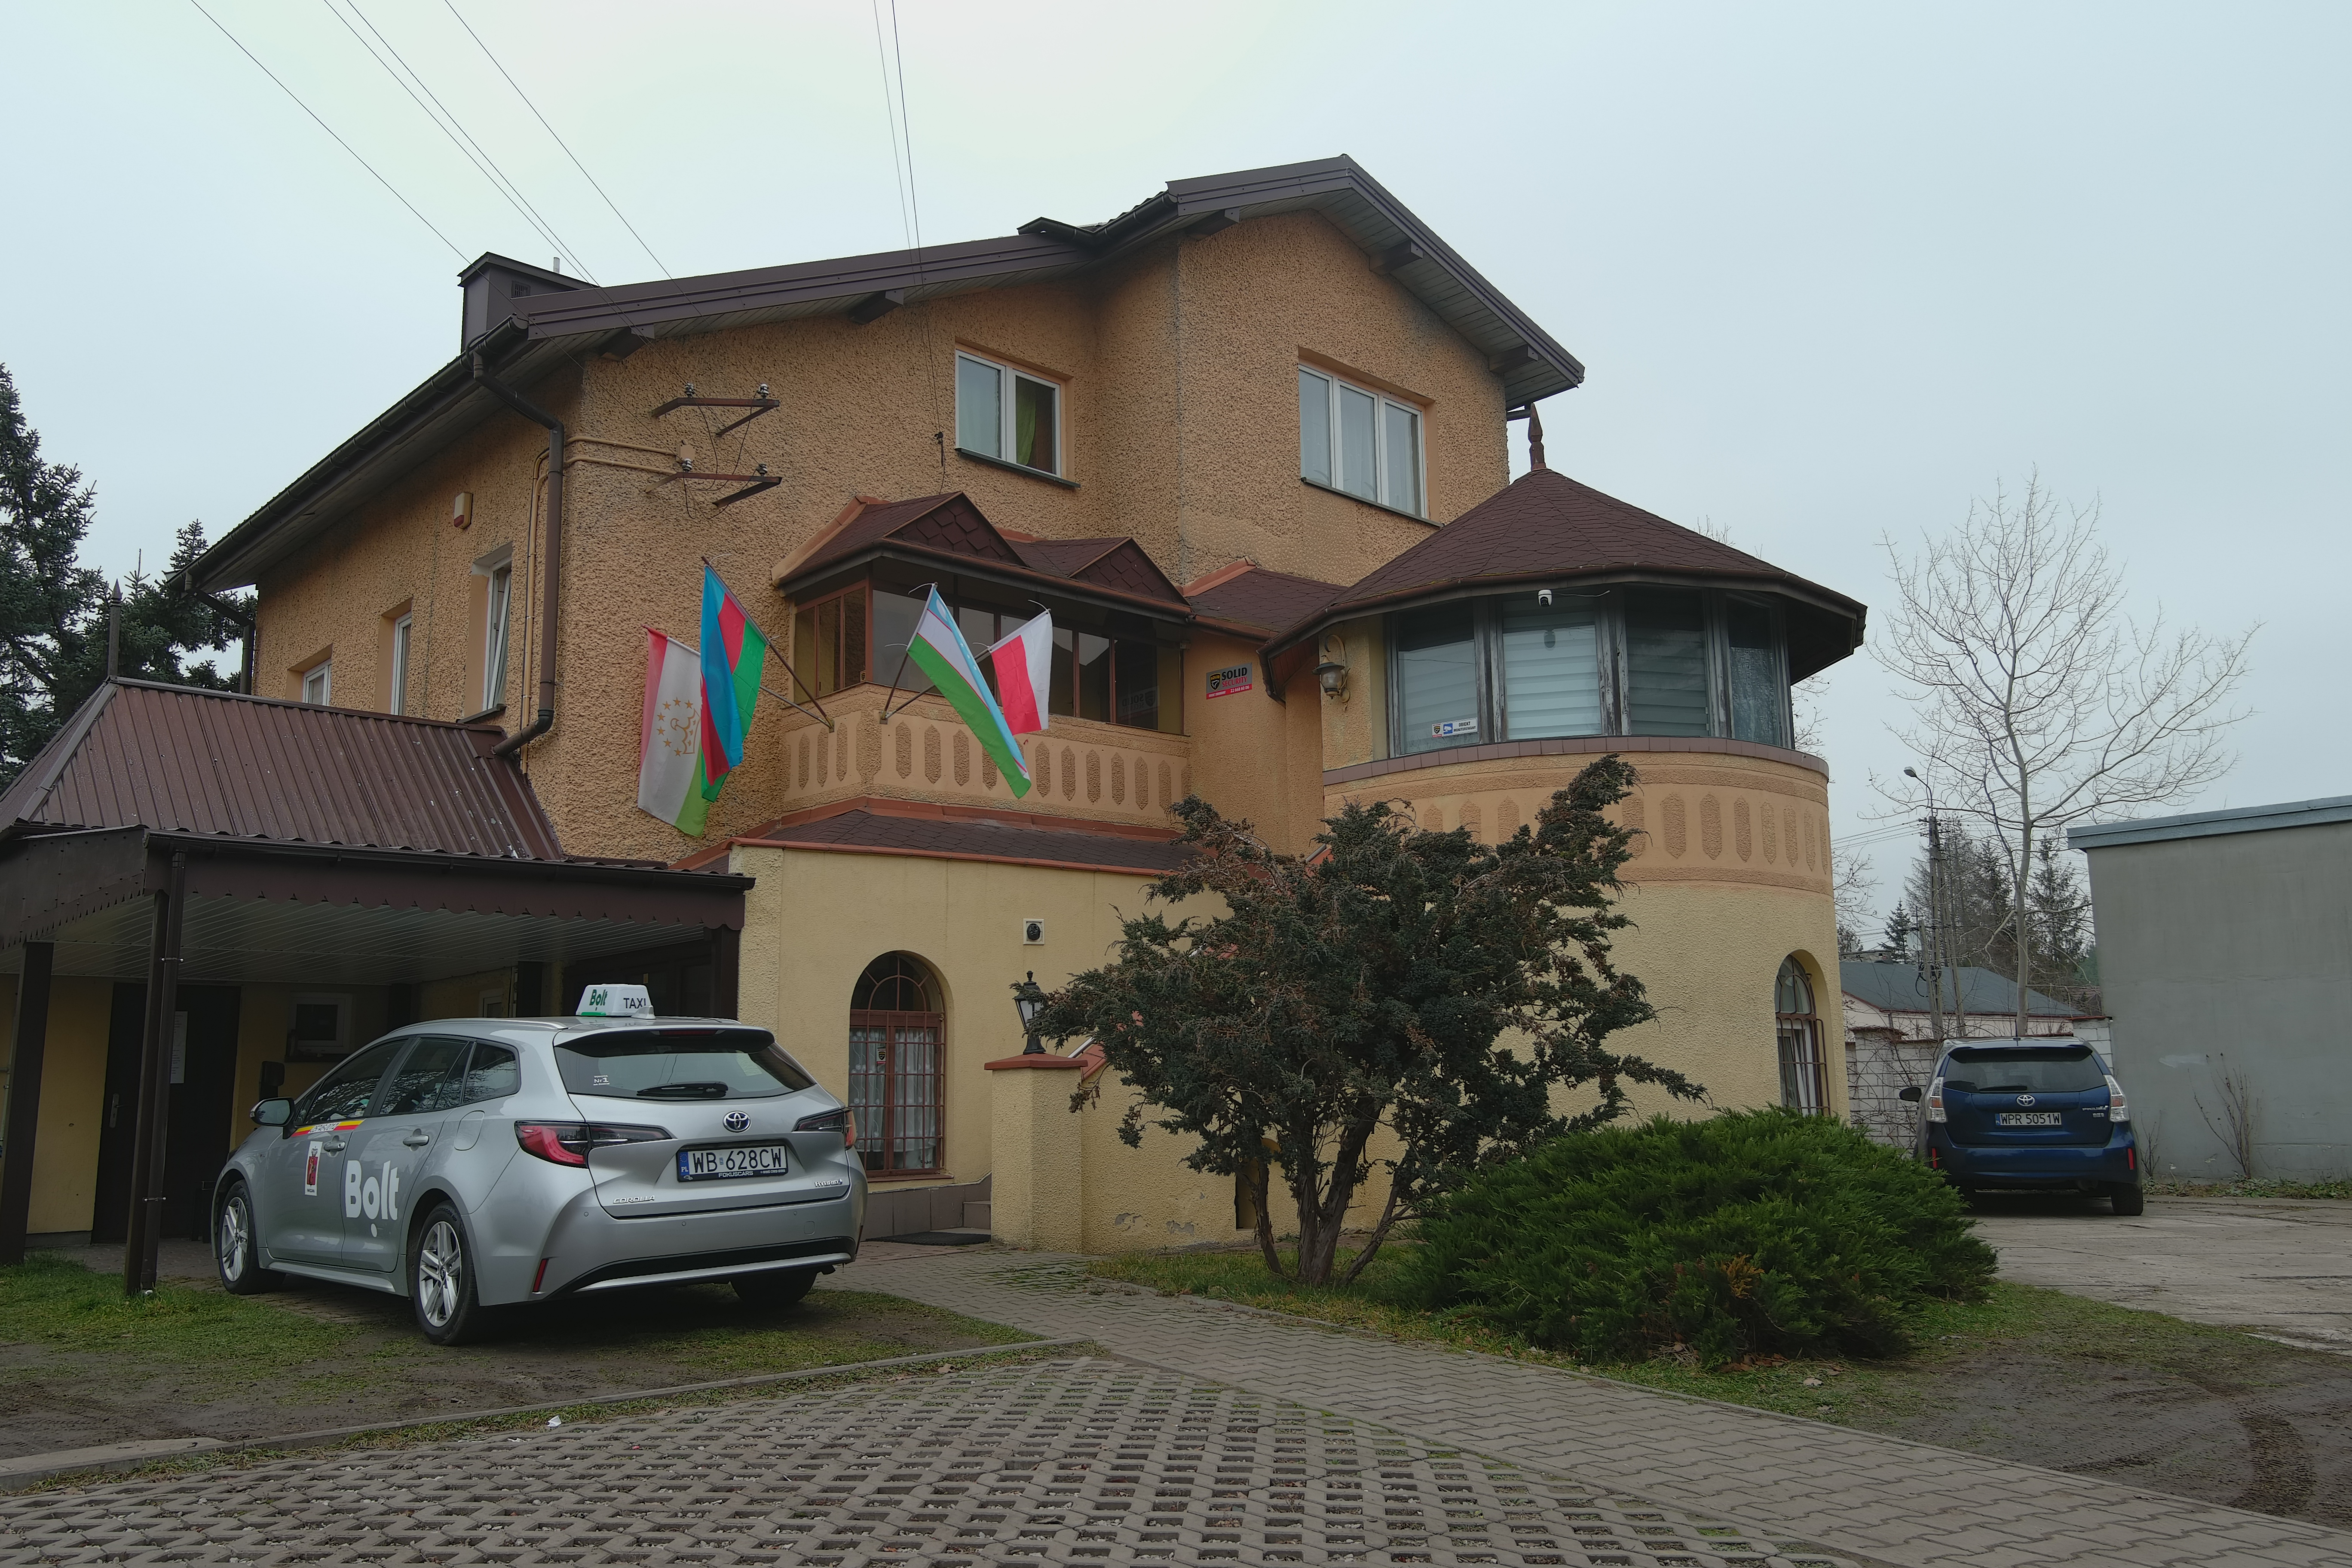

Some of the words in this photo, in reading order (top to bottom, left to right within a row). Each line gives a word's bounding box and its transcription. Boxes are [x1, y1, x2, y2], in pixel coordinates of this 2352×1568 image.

[1222, 667, 1247, 680] SOLID
[1222, 676, 1247, 687] SECURITY
[589, 989, 608, 1006] Bolt
[623, 998, 646, 1009] TAXI
[2001, 1114, 2022, 1124] WPR
[2026, 1114, 2060, 1124] 5051W
[692, 1152, 717, 1173] WB
[726, 1148, 781, 1170] 628CW
[345, 1160, 399, 1221] Bolt
[613, 1195, 655, 1204] COROLLA
